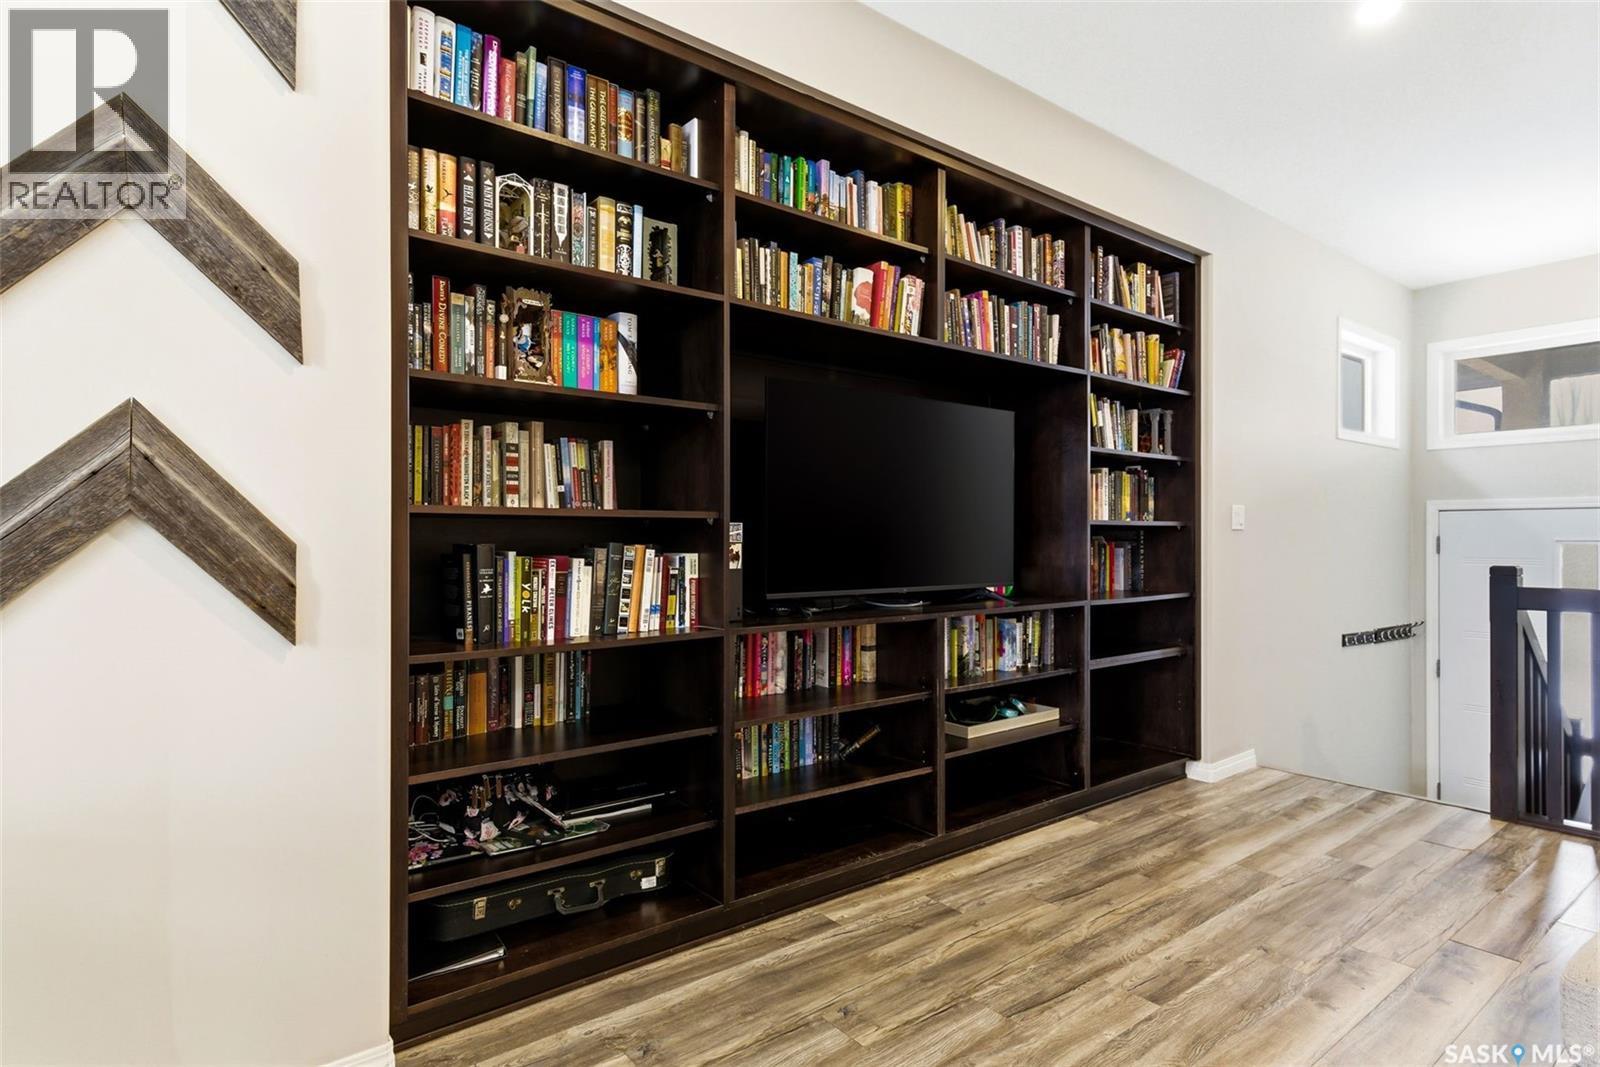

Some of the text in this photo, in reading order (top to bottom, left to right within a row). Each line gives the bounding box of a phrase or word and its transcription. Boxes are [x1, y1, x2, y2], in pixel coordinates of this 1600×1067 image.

[463, 184, 473, 226] HELL BENT
[484, 185, 494, 232] NINTH HOUSE
[438, 303, 446, 329] DIVINE
[439, 332, 447, 364] COMEDY
